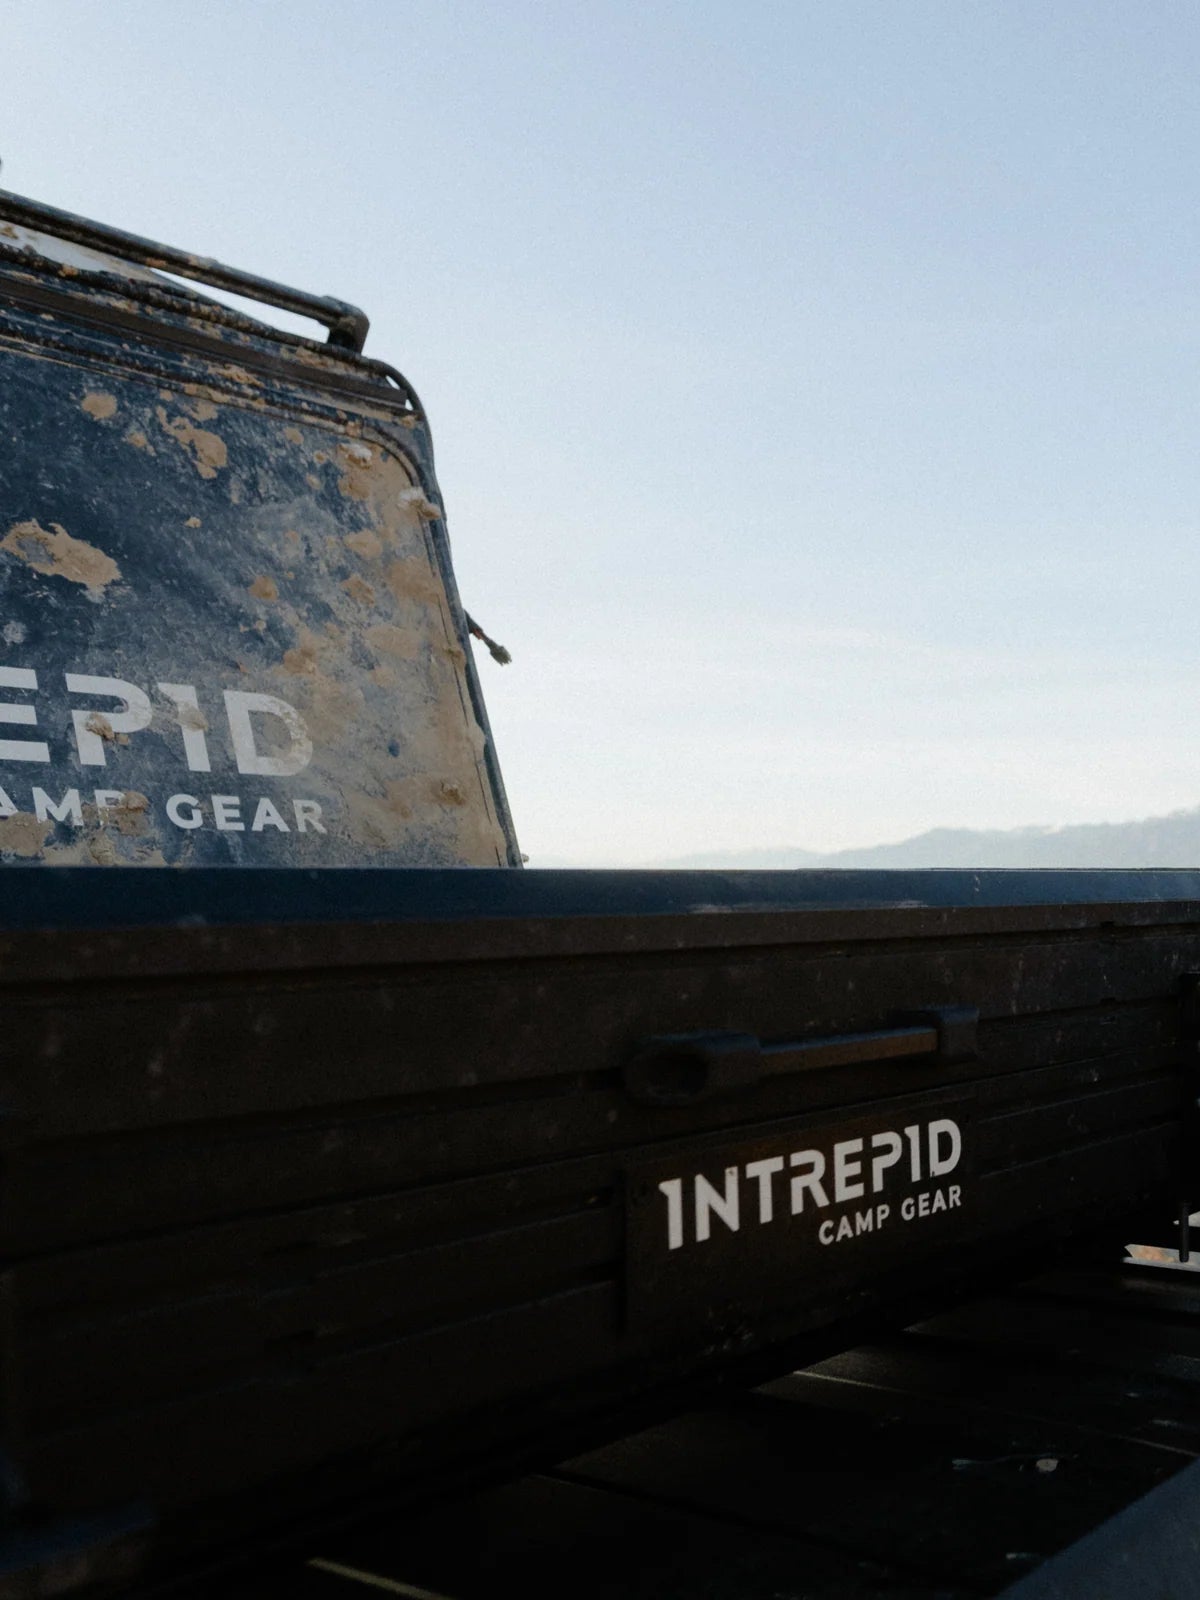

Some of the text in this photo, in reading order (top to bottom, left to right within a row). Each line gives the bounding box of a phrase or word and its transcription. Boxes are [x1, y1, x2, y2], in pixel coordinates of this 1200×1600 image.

[166, 793, 327, 834] GEAR
[818, 1185, 962, 1246] CAMP GEAR
